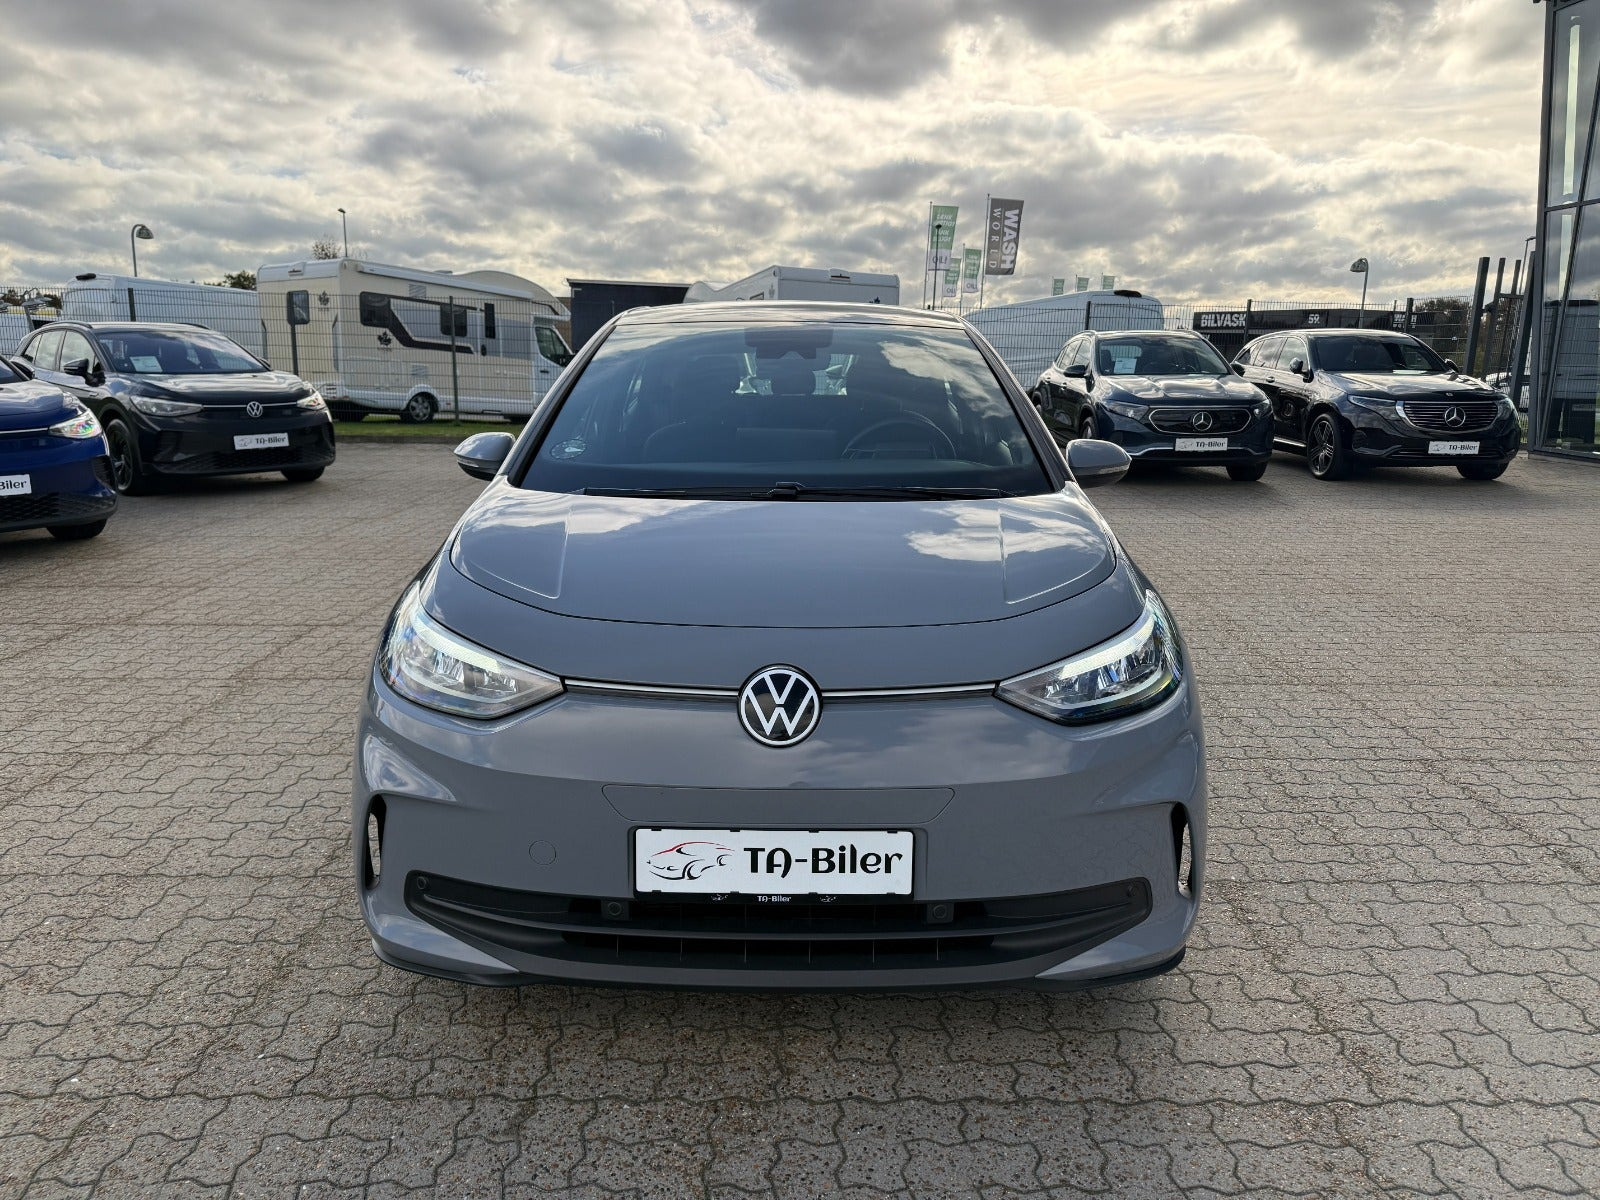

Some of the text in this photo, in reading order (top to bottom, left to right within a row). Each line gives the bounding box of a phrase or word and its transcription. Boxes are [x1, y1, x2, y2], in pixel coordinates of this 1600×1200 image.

[989, 208, 1001, 268] WORLD
[1001, 209, 1020, 269] WASH
[1201, 313, 1246, 327] BILVASK
[743, 844, 903, 879] TA-Biler
